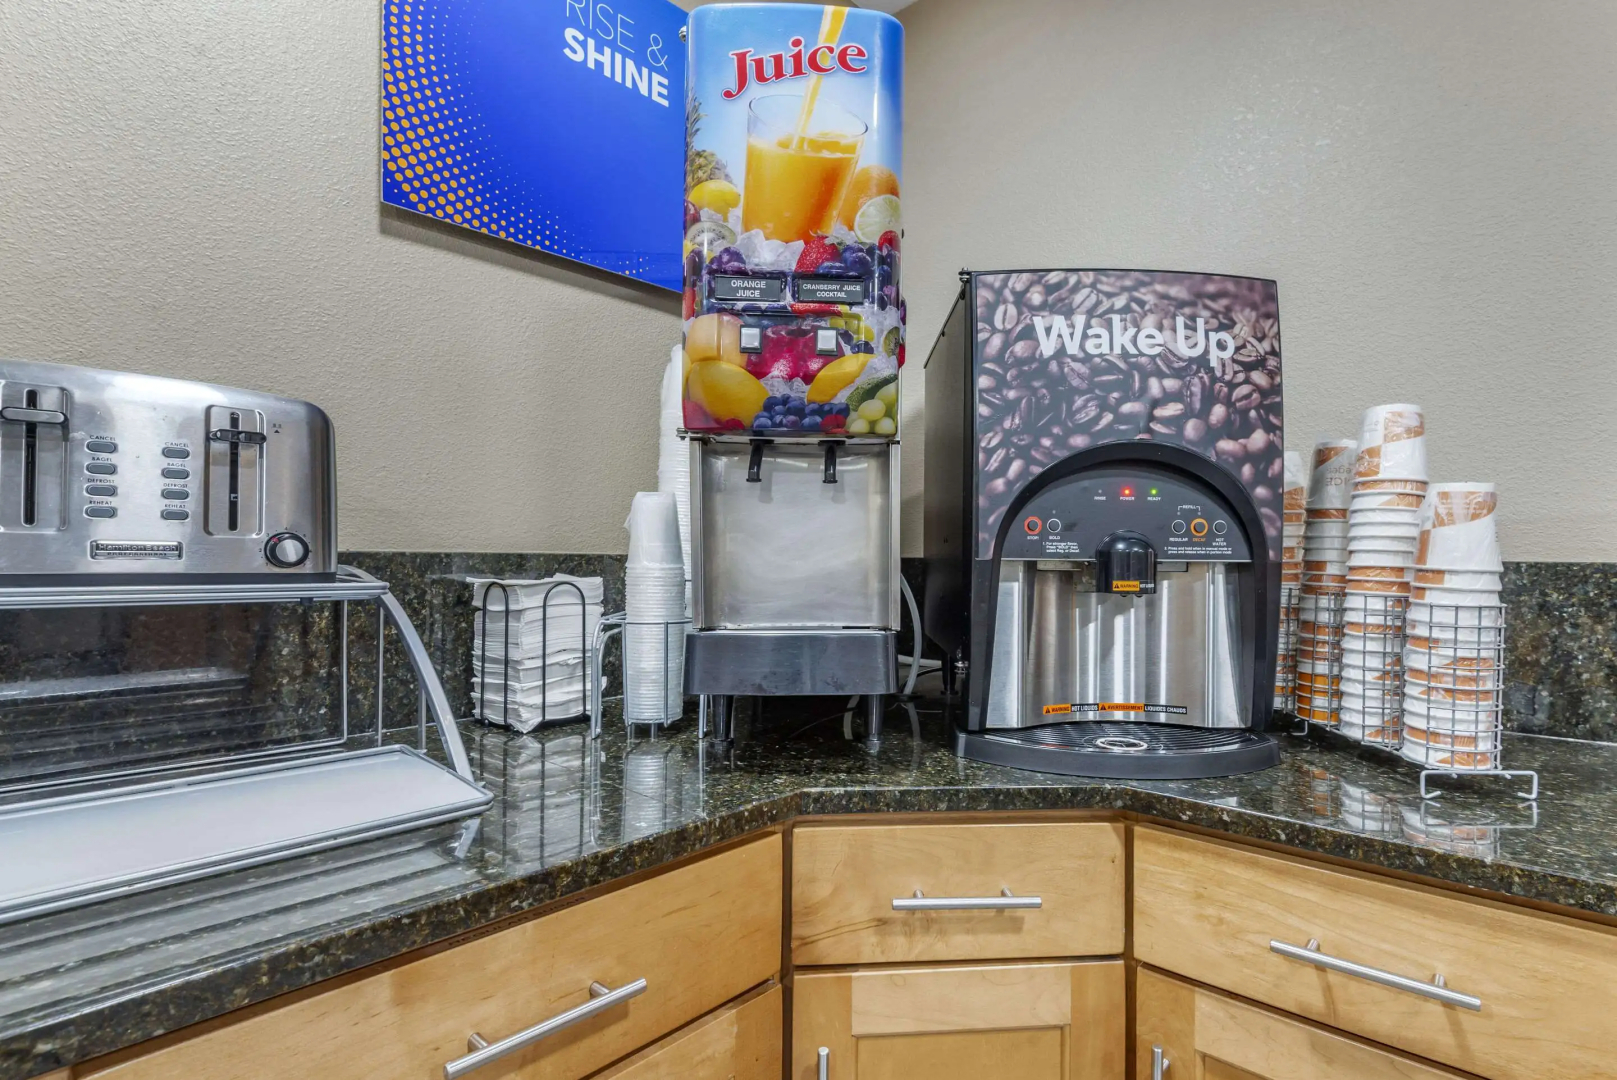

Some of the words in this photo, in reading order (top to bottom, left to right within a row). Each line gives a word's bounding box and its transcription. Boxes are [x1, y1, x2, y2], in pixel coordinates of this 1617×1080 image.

[567, 0, 634, 53] RISE
[647, 34, 668, 71] &
[563, 28, 669, 107] SHINE
[722, 36, 867, 99] Juice
[731, 280, 766, 288] ORANGE
[736, 289, 760, 298] JUICE
[1033, 314, 1165, 358] Wake
[1176, 316, 1235, 367] Up
[448, 916, 528, 946] REGULAR
[532, 896, 585, 916] SUGAR
